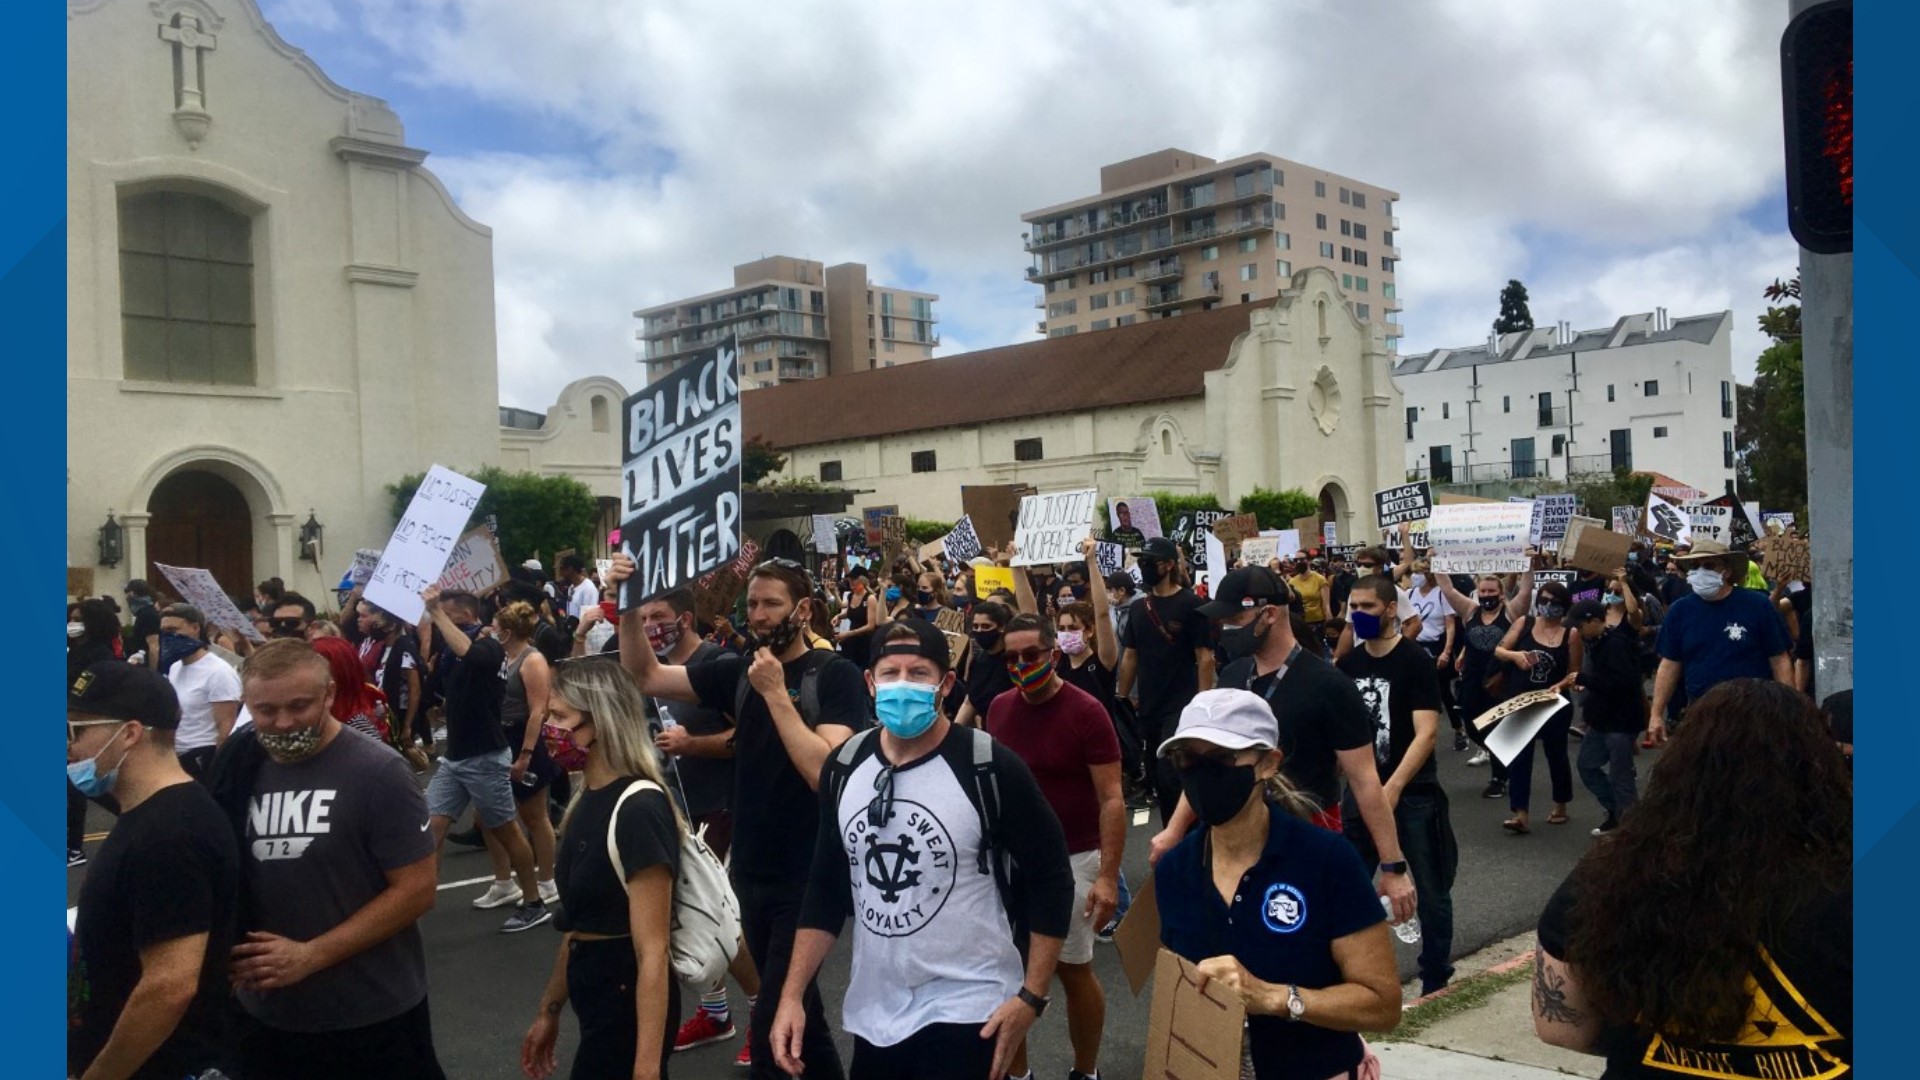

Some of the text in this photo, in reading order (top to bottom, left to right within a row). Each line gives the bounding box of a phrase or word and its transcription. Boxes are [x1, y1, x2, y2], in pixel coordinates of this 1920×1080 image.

[629, 346, 738, 454] BLACK
[624, 418, 732, 513] LIVES
[421, 475, 478, 510] NO JUSTICE
[1020, 496, 1038, 530] NO
[1037, 490, 1097, 529] JUSTICE
[1382, 485, 1421, 503] BLACK
[1388, 498, 1418, 512] LIVES
[1568, 497, 1575, 505] A
[1381, 508, 1430, 526] MATTER
[397, 517, 451, 553] NO PEACE
[618, 491, 739, 611] MATTER
[1021, 530, 1044, 561] NO
[1043, 527, 1077, 559] PEACE
[374, 561, 390, 579] NO
[1432, 559, 1529, 573] BLACK LIVES MATTER
[246, 790, 337, 837] NIKE
[907, 812, 949, 869] SWEAT
